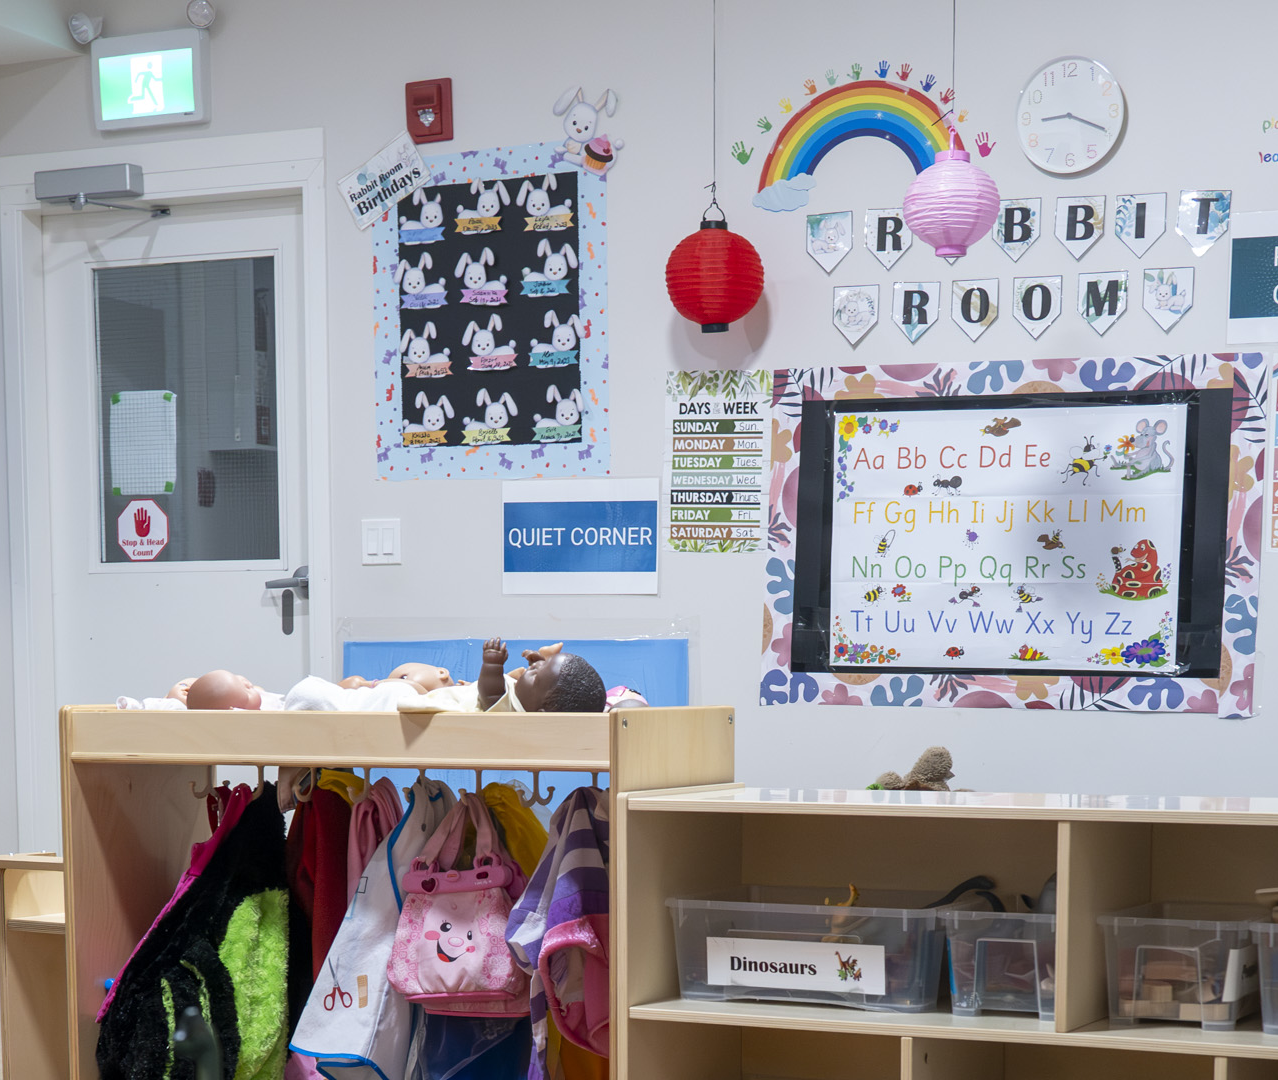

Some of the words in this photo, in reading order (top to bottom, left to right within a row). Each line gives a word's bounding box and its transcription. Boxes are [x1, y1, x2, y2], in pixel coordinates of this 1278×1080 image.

[1062, 62, 1078, 78] 12
[1090, 66, 1094, 82] 1
[1043, 71, 1055, 87] 11
[1102, 80, 1112, 96] 2
[1028, 90, 1043, 105] 10
[1108, 104, 1119, 118] 3
[1022, 112, 1031, 126] 9
[1028, 132, 1038, 148] 8
[1044, 148, 1055, 163] 7
[1087, 144, 1098, 159] 5
[1065, 153, 1076, 167] 6
[349, 179, 378, 202] Rabbit
[378, 162, 404, 184] Room
[356, 167, 421, 216] Birthdays
[877, 197, 1220, 252] RBBIT
[902, 278, 1120, 325] ROOM
[678, 402, 711, 415] DAYS
[723, 402, 758, 415] WEEK
[674, 422, 719, 432] SUNDAY
[739, 422, 759, 431] Sun.
[674, 439, 726, 450] MONDAY
[737, 440, 760, 449] Mon.
[674, 457, 722, 468] TUESDAY
[736, 458, 759, 467] Tues.
[852, 447, 886, 470] Aa
[896, 446, 927, 470] Bb
[938, 445, 968, 469] Cc
[978, 444, 1012, 469] Dd
[1024, 444, 1052, 468] Ee
[673, 475, 731, 485] WEDNESDAY
[736, 475, 758, 485] Wed.
[672, 492, 729, 503] THURSDAY
[672, 510, 710, 520] FRIDAY
[738, 510, 753, 520] Fri.
[852, 501, 874, 524] Ff
[884, 501, 916, 532] Gg
[928, 501, 960, 524] Hh
[972, 500, 985, 524] Ii
[996, 500, 1014, 532] Jj
[1026, 500, 1055, 523] Kk
[1100, 499, 1146, 522] Mm
[508, 528, 566, 549] QUIET
[571, 527, 652, 546] CORNER
[672, 528, 729, 538] SATURDAY
[122, 539, 137, 547] Stop
[146, 537, 164, 546] Head
[132, 549, 153, 557] Count
[852, 556, 882, 579] Nn
[894, 556, 926, 579] Oo
[938, 556, 967, 587] Pp
[979, 556, 1013, 587] Qq
[1025, 556, 1051, 579] Rr
[1062, 556, 1086, 579] Ss
[851, 610, 873, 633] Tt
[884, 611, 915, 633] Uu
[928, 611, 957, 634] Vv
[968, 611, 1014, 634] Ww
[1025, 612, 1054, 635] Xx
[1066, 612, 1094, 643] Yy
[1105, 612, 1132, 635] Zz
[730, 955, 818, 977] Dinosaurs
